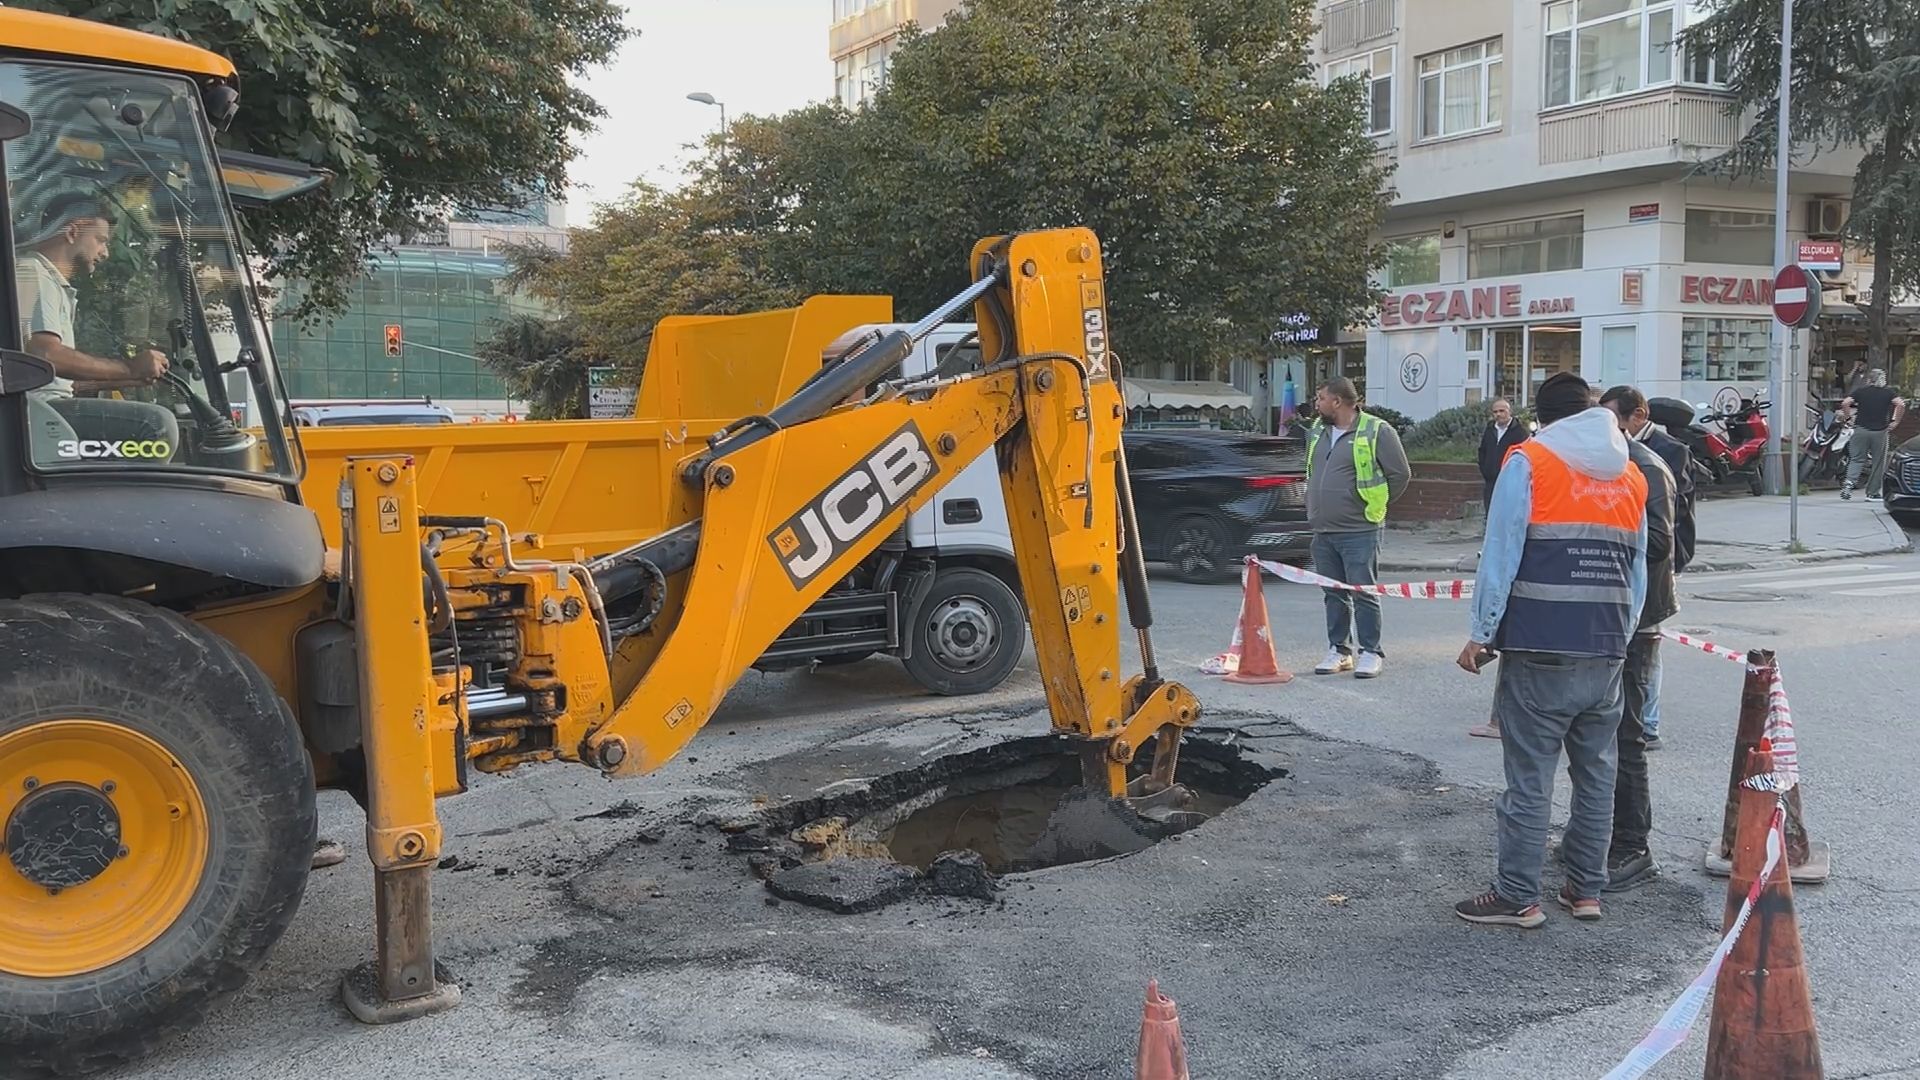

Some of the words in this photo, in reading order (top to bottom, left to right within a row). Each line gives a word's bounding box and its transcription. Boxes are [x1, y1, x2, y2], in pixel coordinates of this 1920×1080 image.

[1800, 246, 1834, 255] SELÇUKLAR
[1624, 279, 1639, 299] E
[1680, 276, 1775, 305] ECZAN
[1380, 284, 1522, 326] ECZANE
[1528, 297, 1575, 315] ARAN
[1084, 309, 1107, 376] 3CX
[788, 431, 932, 578] JCB
